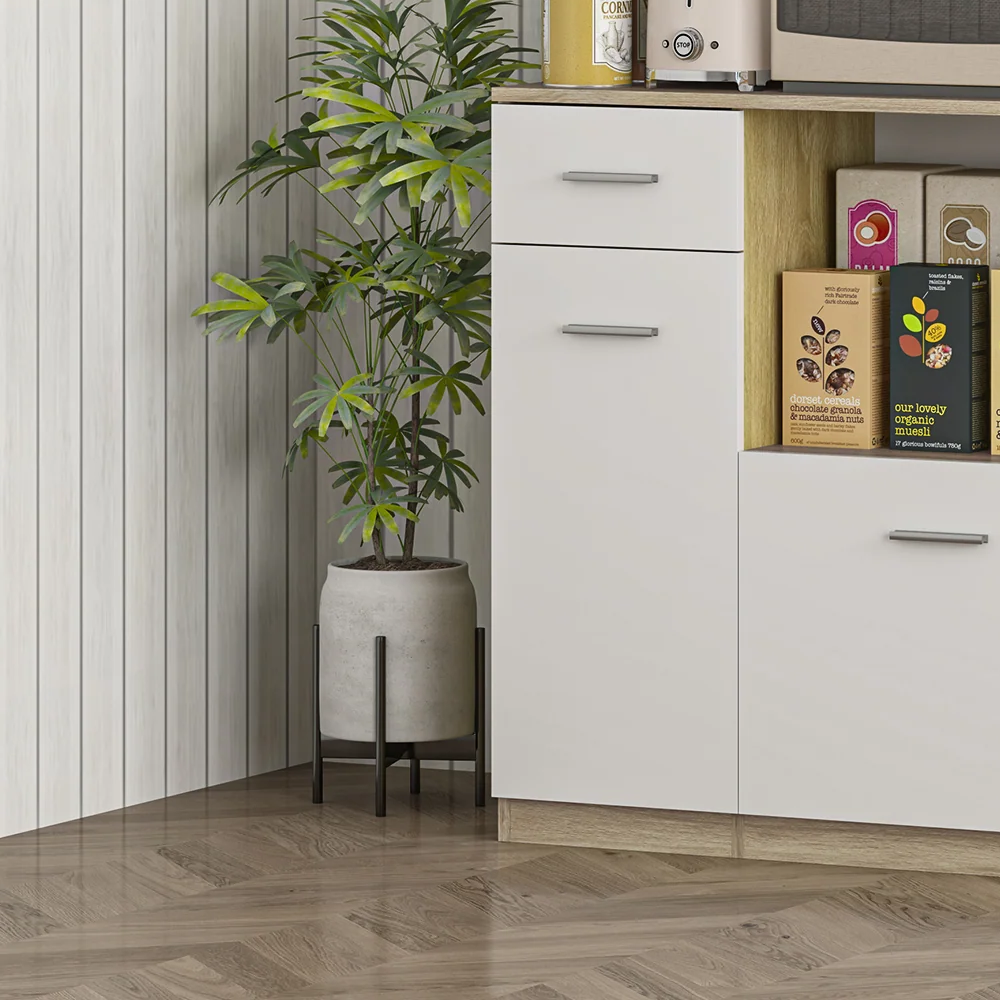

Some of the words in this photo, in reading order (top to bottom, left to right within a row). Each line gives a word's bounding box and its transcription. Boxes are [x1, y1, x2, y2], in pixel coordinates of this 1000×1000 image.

[790, 394, 822, 405] dorset
[824, 396, 860, 406] cereals
[790, 404, 829, 413] chocolate
[830, 406, 862, 415] granola
[894, 403, 914, 413] our
[915, 402, 948, 416] lovely
[790, 412, 798, 421] &
[799, 413, 845, 423] macadamia
[845, 415, 865, 424] nuts
[894, 415, 935, 426] organic
[894, 426, 931, 437] muesli
[901, 440, 924, 448] glorious
[924, 441, 947, 449] bowlfuls
